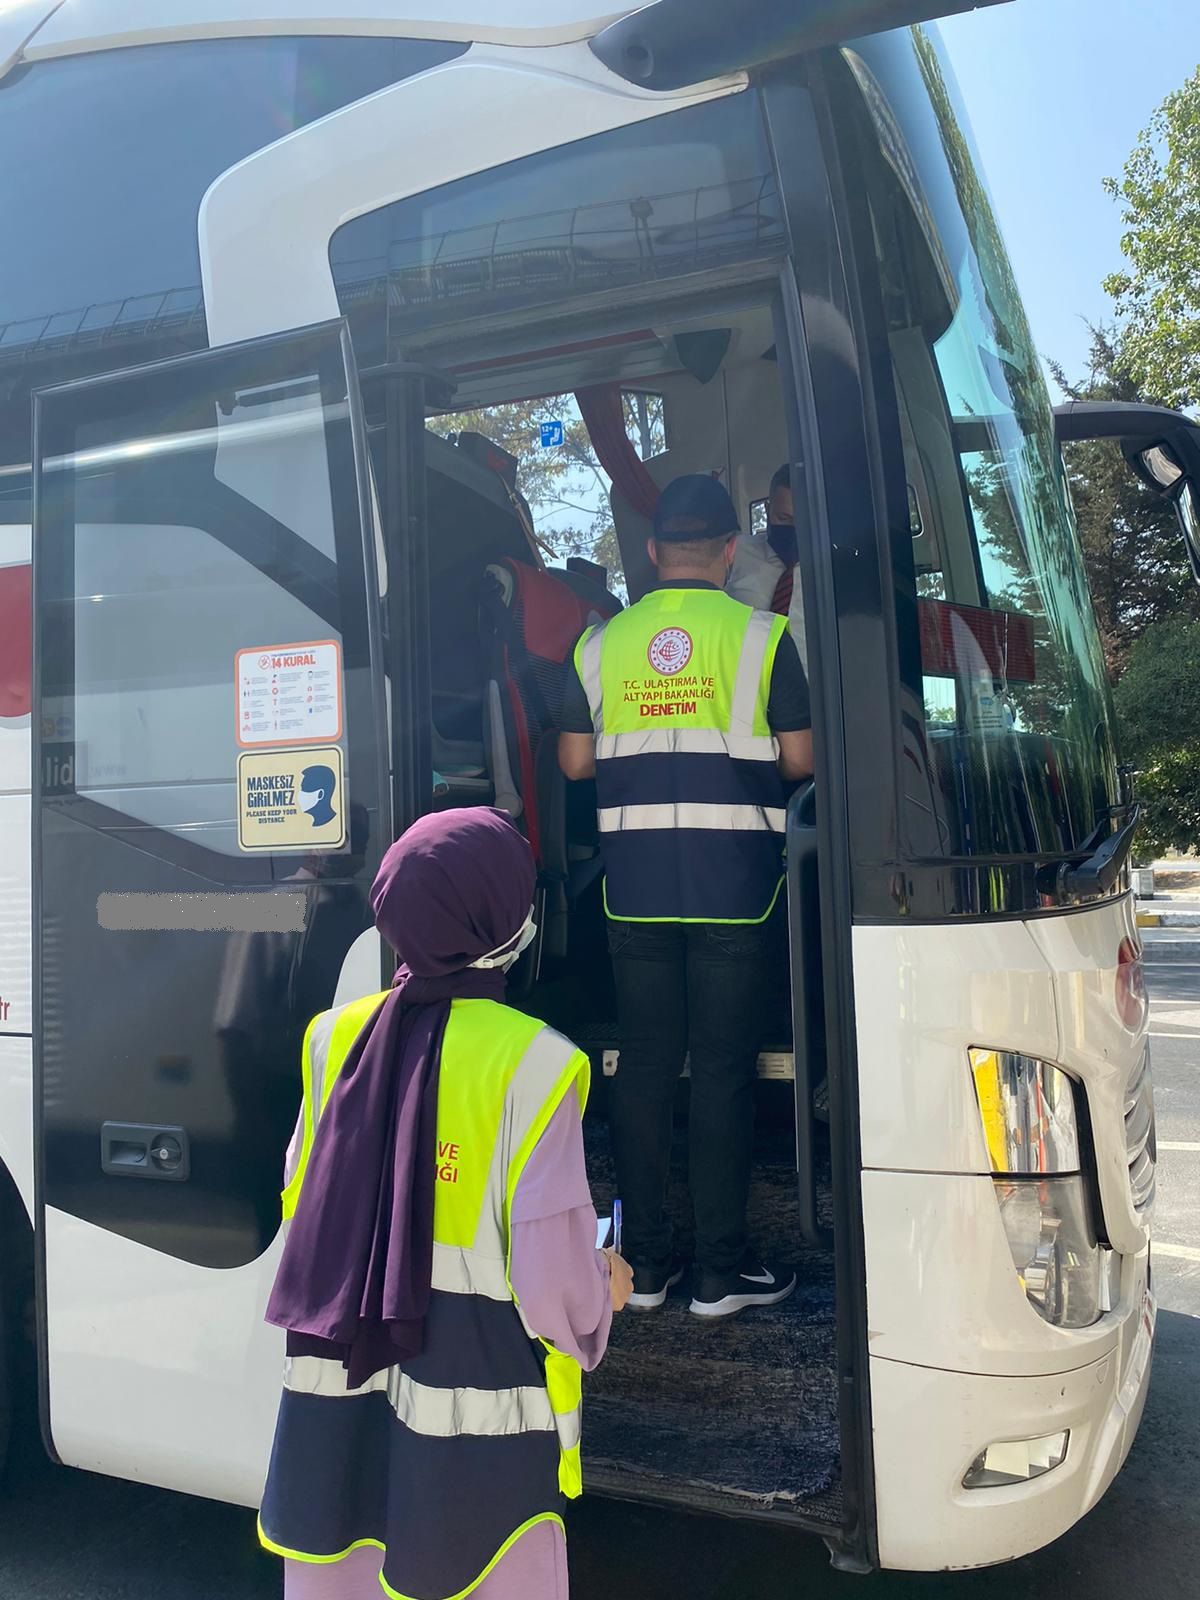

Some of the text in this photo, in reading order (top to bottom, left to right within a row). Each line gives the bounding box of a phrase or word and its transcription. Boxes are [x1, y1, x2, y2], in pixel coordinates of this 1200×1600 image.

[271, 654, 316, 669] 14 KURAL
[623, 676, 714, 690] T.C. ULAŞTIRMA VE
[664, 688, 715, 700] BAKANLIĞI
[639, 699, 697, 717] DENETİM
[258, 816, 285, 824] DISTANCE
[267, 809, 282, 817] KEEP
[438, 1140, 460, 1160] VE
